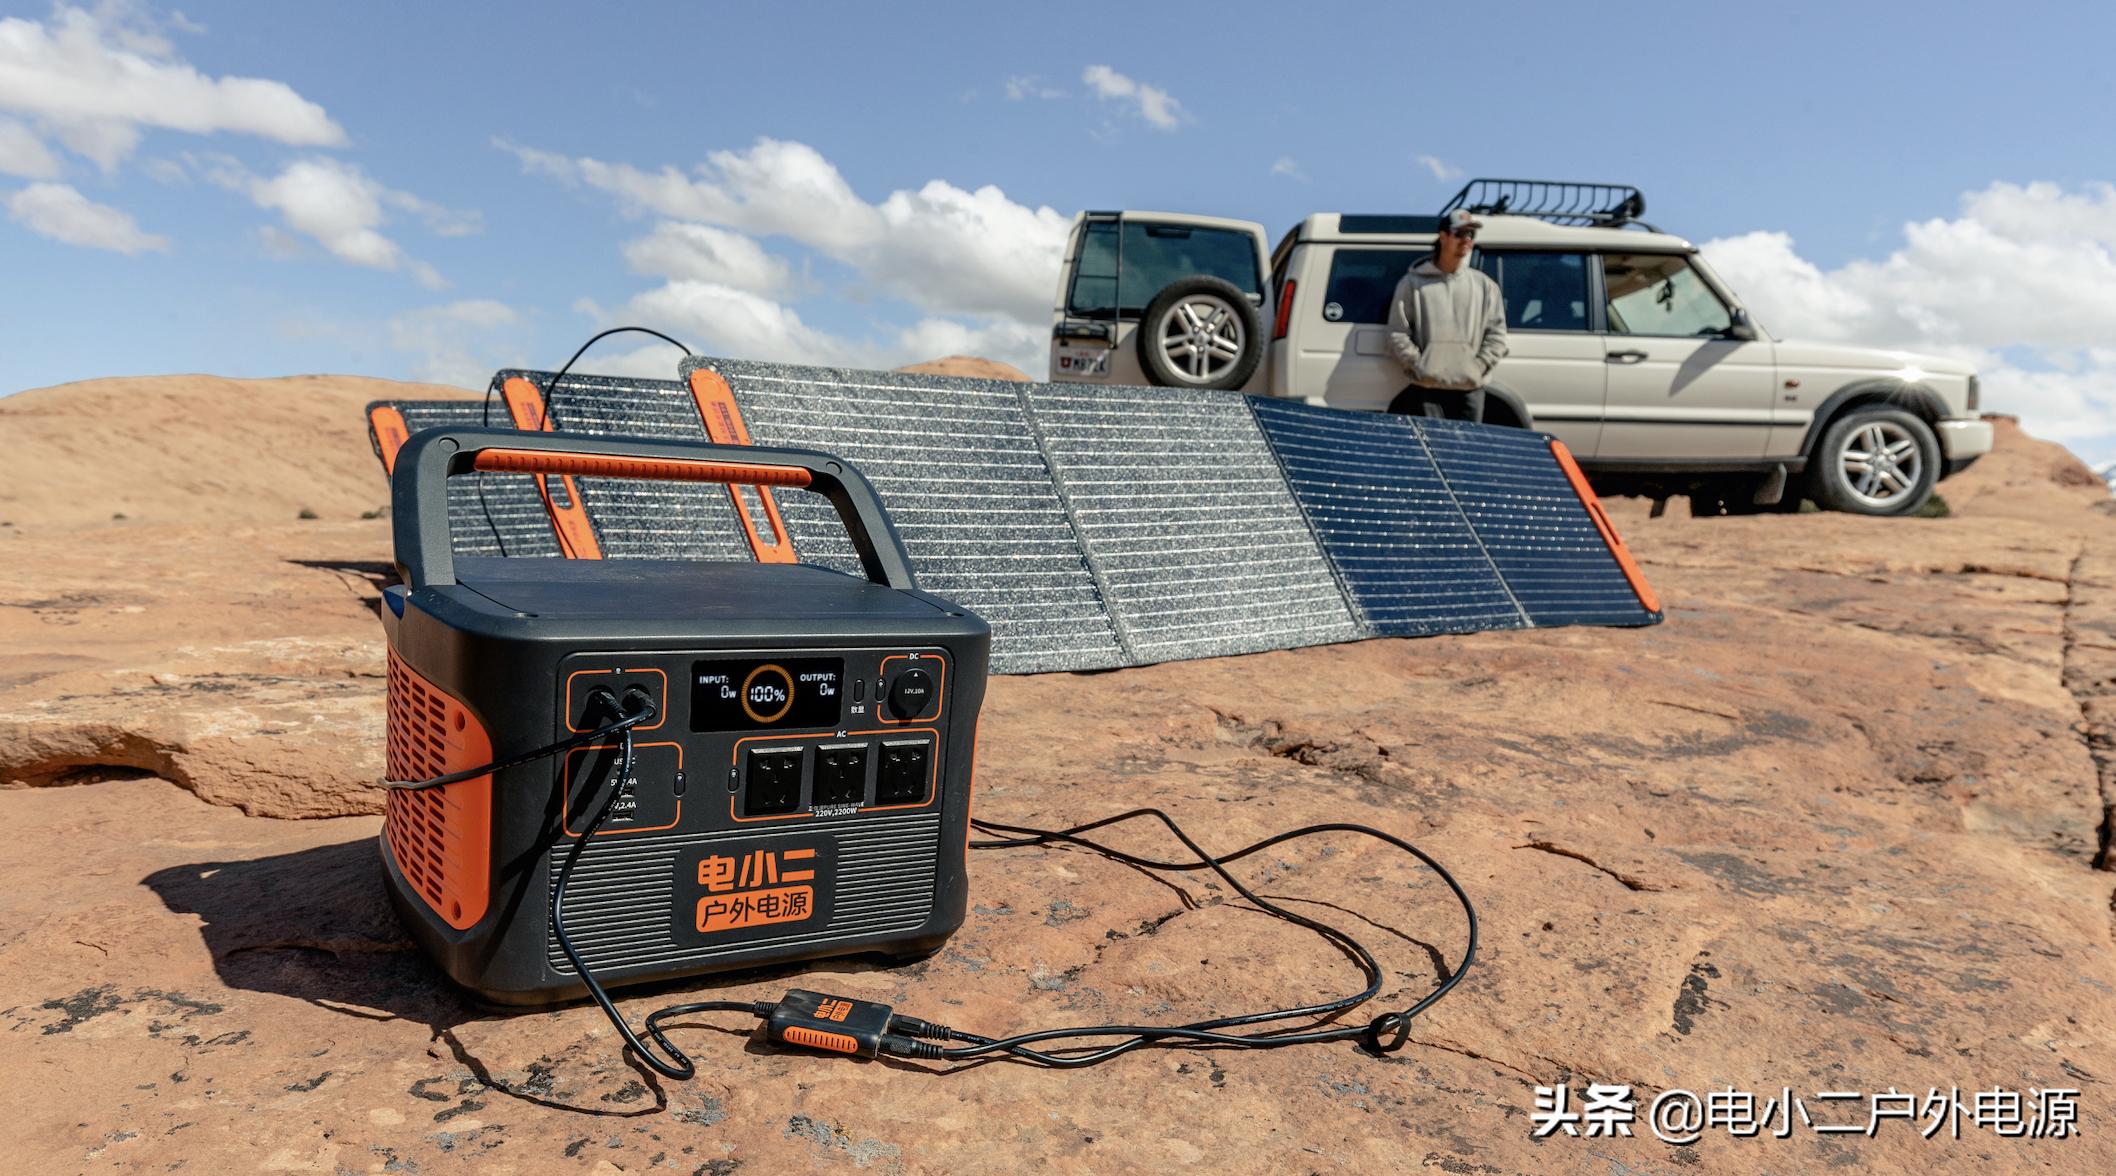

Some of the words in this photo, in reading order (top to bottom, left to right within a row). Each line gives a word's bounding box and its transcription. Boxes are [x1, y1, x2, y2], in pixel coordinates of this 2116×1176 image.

[909, 652, 919, 660] DC
[699, 675, 729, 684] INPUT:
[799, 673, 836, 682] OUTPUT:
[750, 686, 786, 702] 100%
[836, 730, 847, 738] AC
[815, 807, 858, 818] 220V,2200W
[697, 848, 817, 892] 电小二
[701, 892, 808, 928] 户外电源
